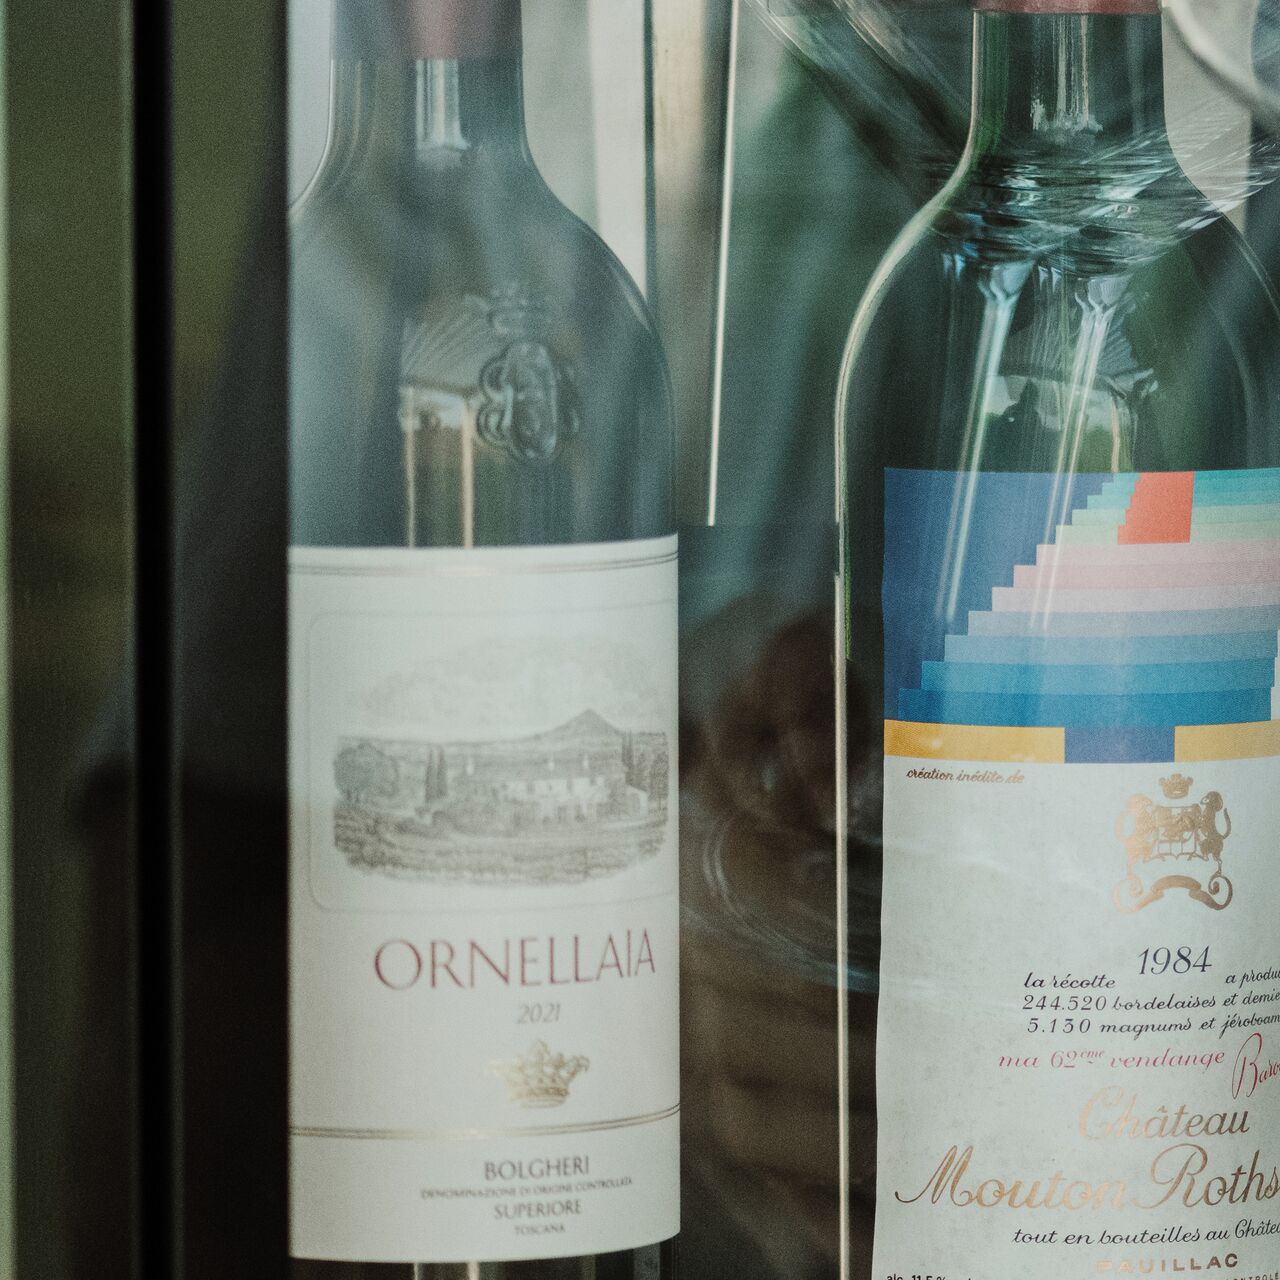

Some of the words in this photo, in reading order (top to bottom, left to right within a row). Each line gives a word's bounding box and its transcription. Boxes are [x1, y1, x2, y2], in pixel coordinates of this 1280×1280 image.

[906, 767, 953, 780] création
[374, 928, 656, 991] ORNELLAIA
[1024, 972, 1045, 989] la
[1051, 973, 1116, 989] récolte
[1137, 945, 1213, 975] 1984
[1225, 974, 1237, 984] a
[516, 1002, 561, 1024] 2021
[1022, 995, 1107, 1011] 244.520
[1112, 993, 1216, 1011] bordelaises
[1223, 992, 1239, 1007] et
[1027, 1017, 1091, 1034] 5.130
[1100, 1019, 1192, 1040] magnums
[1200, 1017, 1216, 1030] et
[999, 1055, 1039, 1068] ma
[1110, 1048, 1225, 1072] vendange
[1078, 1084, 1249, 1141] Château
[484, 1154, 590, 1182] BOLGHERI
[894, 1145, 1130, 1210] Mouton
[494, 1199, 582, 1221] SUPERIORE
[1013, 1228, 1058, 1244] tout
[1065, 1232, 1092, 1244] en
[1099, 1226, 1201, 1244] bouteilles
[1204, 1231, 1230, 1241] au
[1094, 1253, 1238, 1274] PAUILLAC
